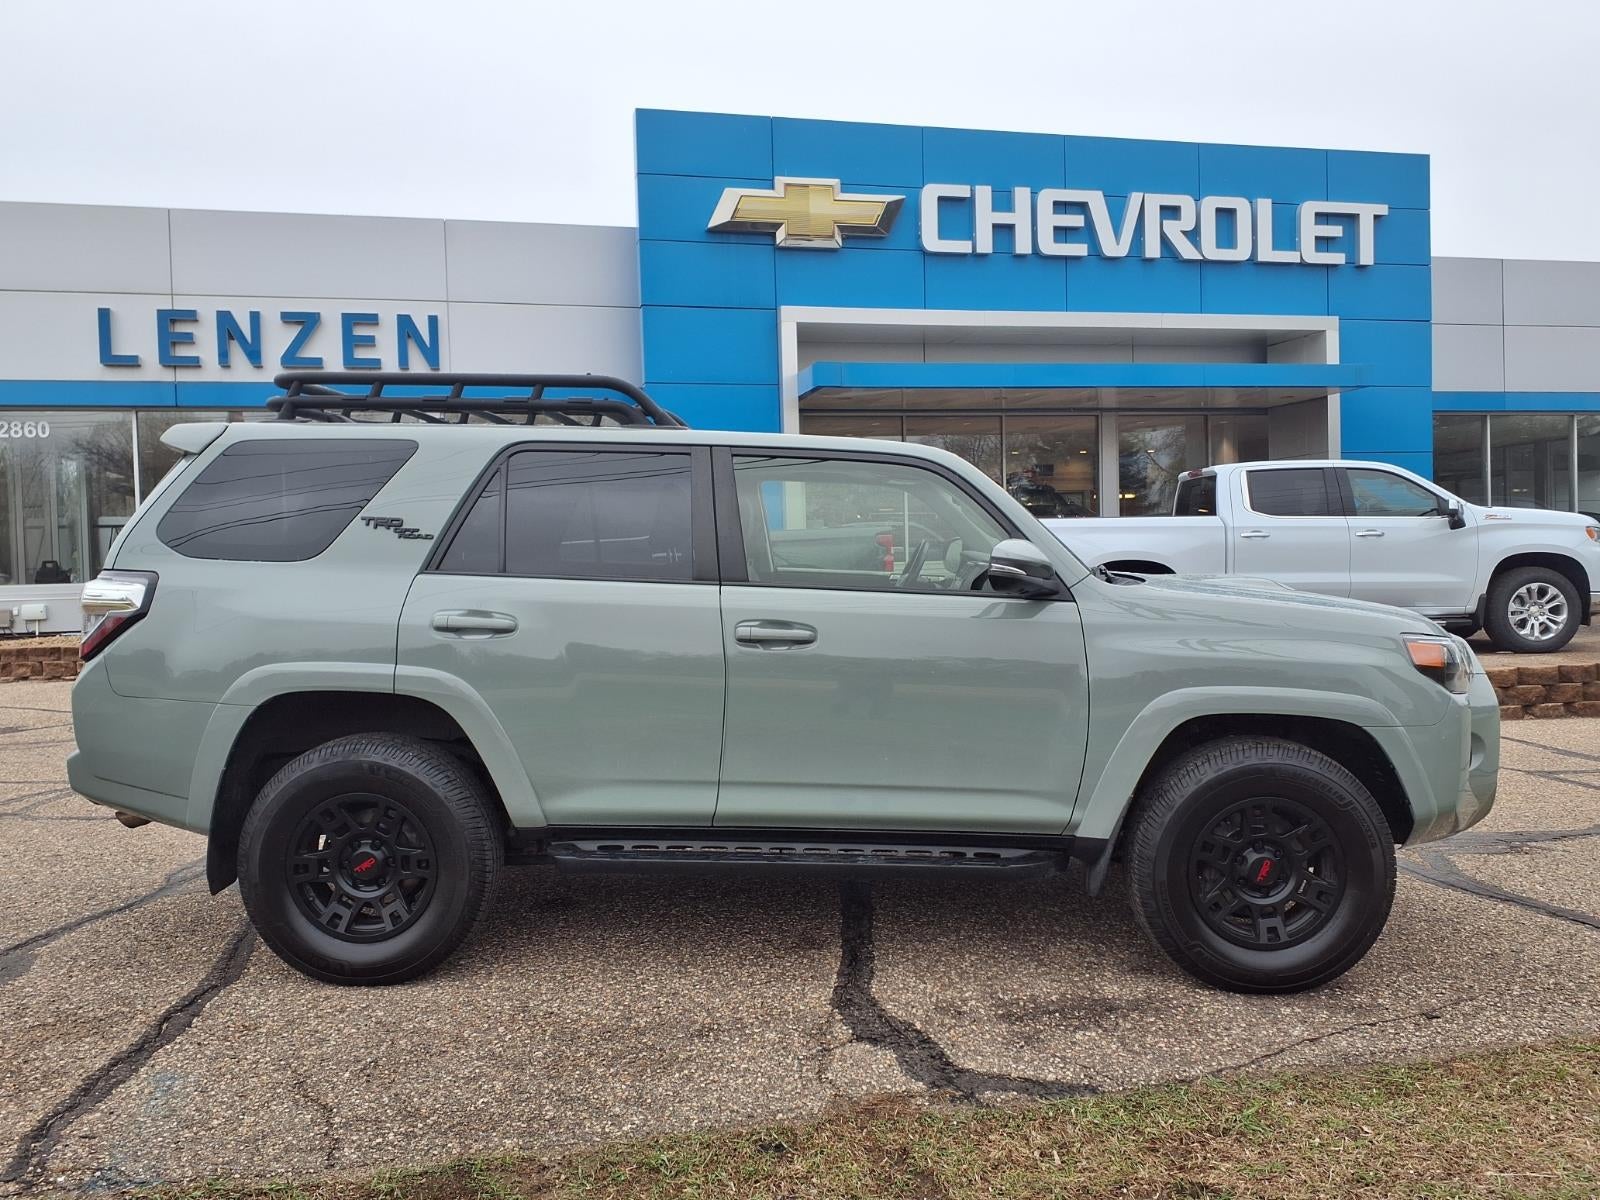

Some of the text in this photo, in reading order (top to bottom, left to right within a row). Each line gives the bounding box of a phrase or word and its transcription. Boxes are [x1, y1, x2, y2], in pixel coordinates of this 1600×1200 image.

[920, 183, 1388, 266] CHEVROLET
[98, 307, 440, 370] LENZEN
[0, 420, 50, 438] 2860
[361, 516, 404, 530] TRD
